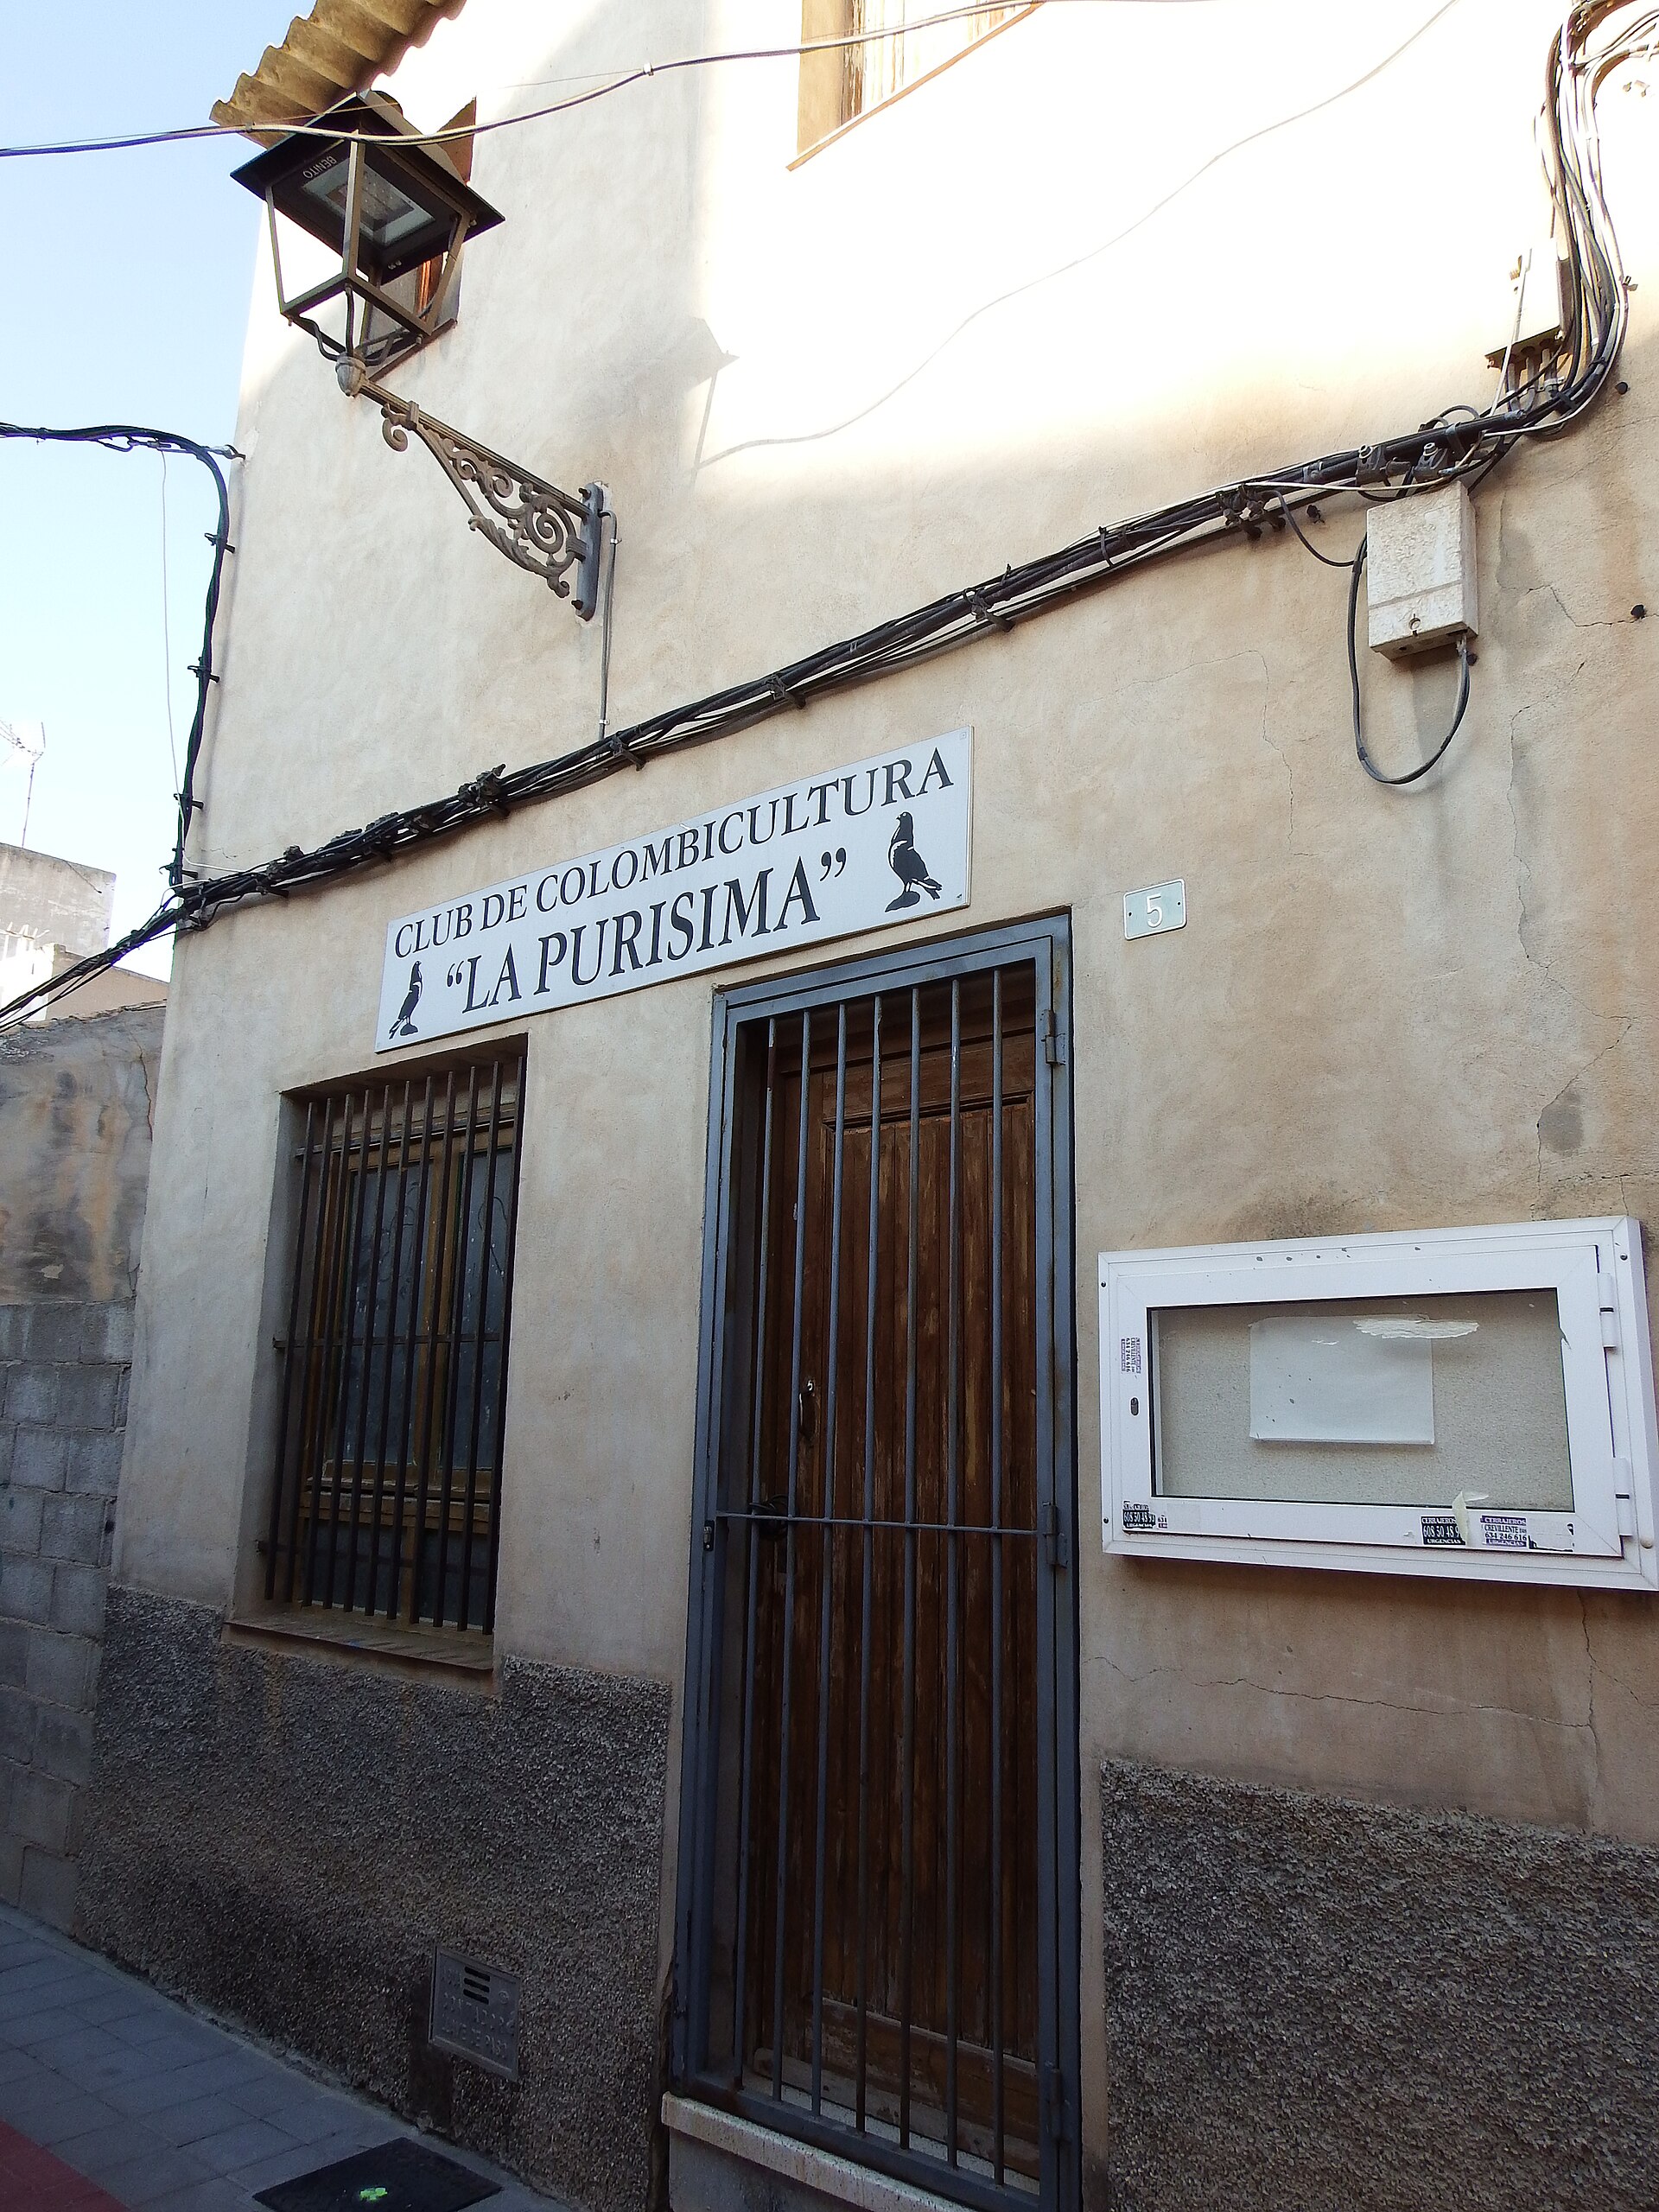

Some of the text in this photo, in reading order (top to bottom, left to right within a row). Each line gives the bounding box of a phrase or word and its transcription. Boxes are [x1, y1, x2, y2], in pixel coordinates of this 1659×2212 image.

[302, 156, 337, 179] BENITO
[396, 747, 955, 957] CLUB DE COLOMBICULTURA
[1147, 893, 1163, 928] 5
[1484, 1516, 1527, 1526] CERRAJEROS
[1484, 1524, 1518, 1534] CREVILLENTE
